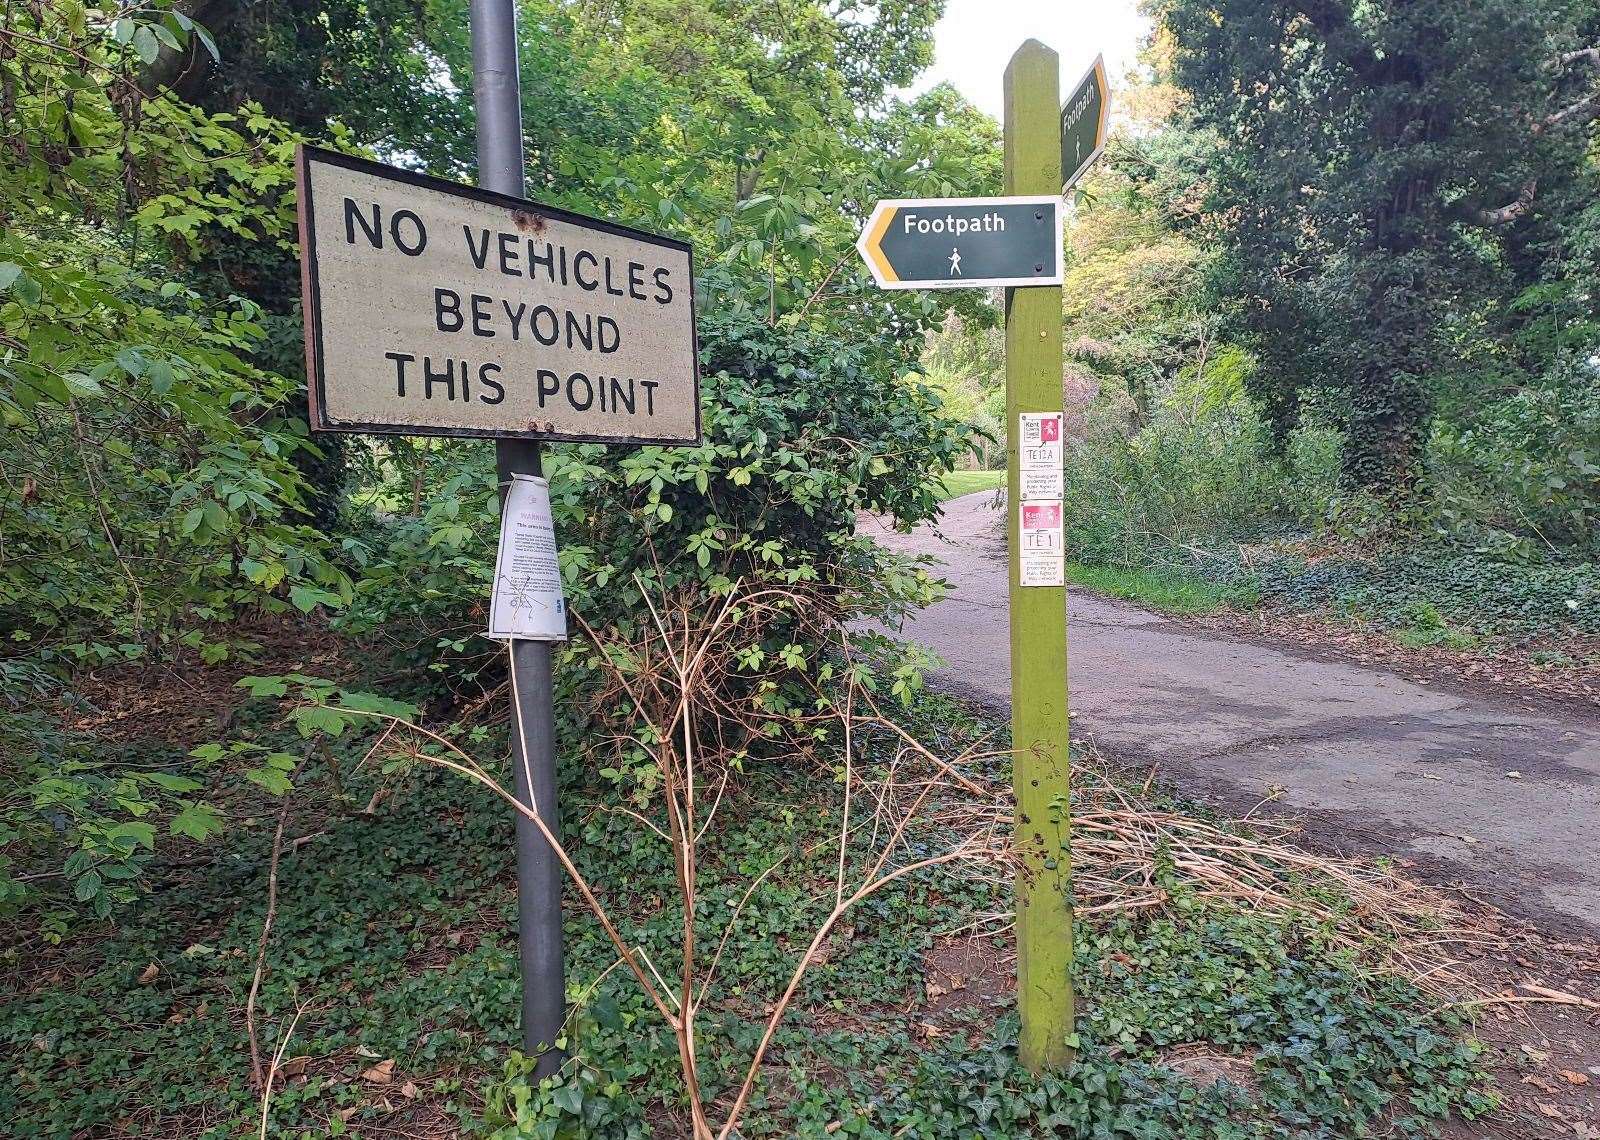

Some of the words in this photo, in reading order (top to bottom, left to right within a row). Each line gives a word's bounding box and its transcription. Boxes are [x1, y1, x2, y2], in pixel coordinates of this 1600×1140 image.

[1063, 81, 1095, 135] Footpath
[343, 197, 428, 257] NO
[463, 225, 674, 304] VEHICLES
[904, 212, 1005, 236] Footpath
[434, 287, 621, 354] BEYOND
[385, 352, 505, 405] THIS
[537, 369, 659, 416] POINT
